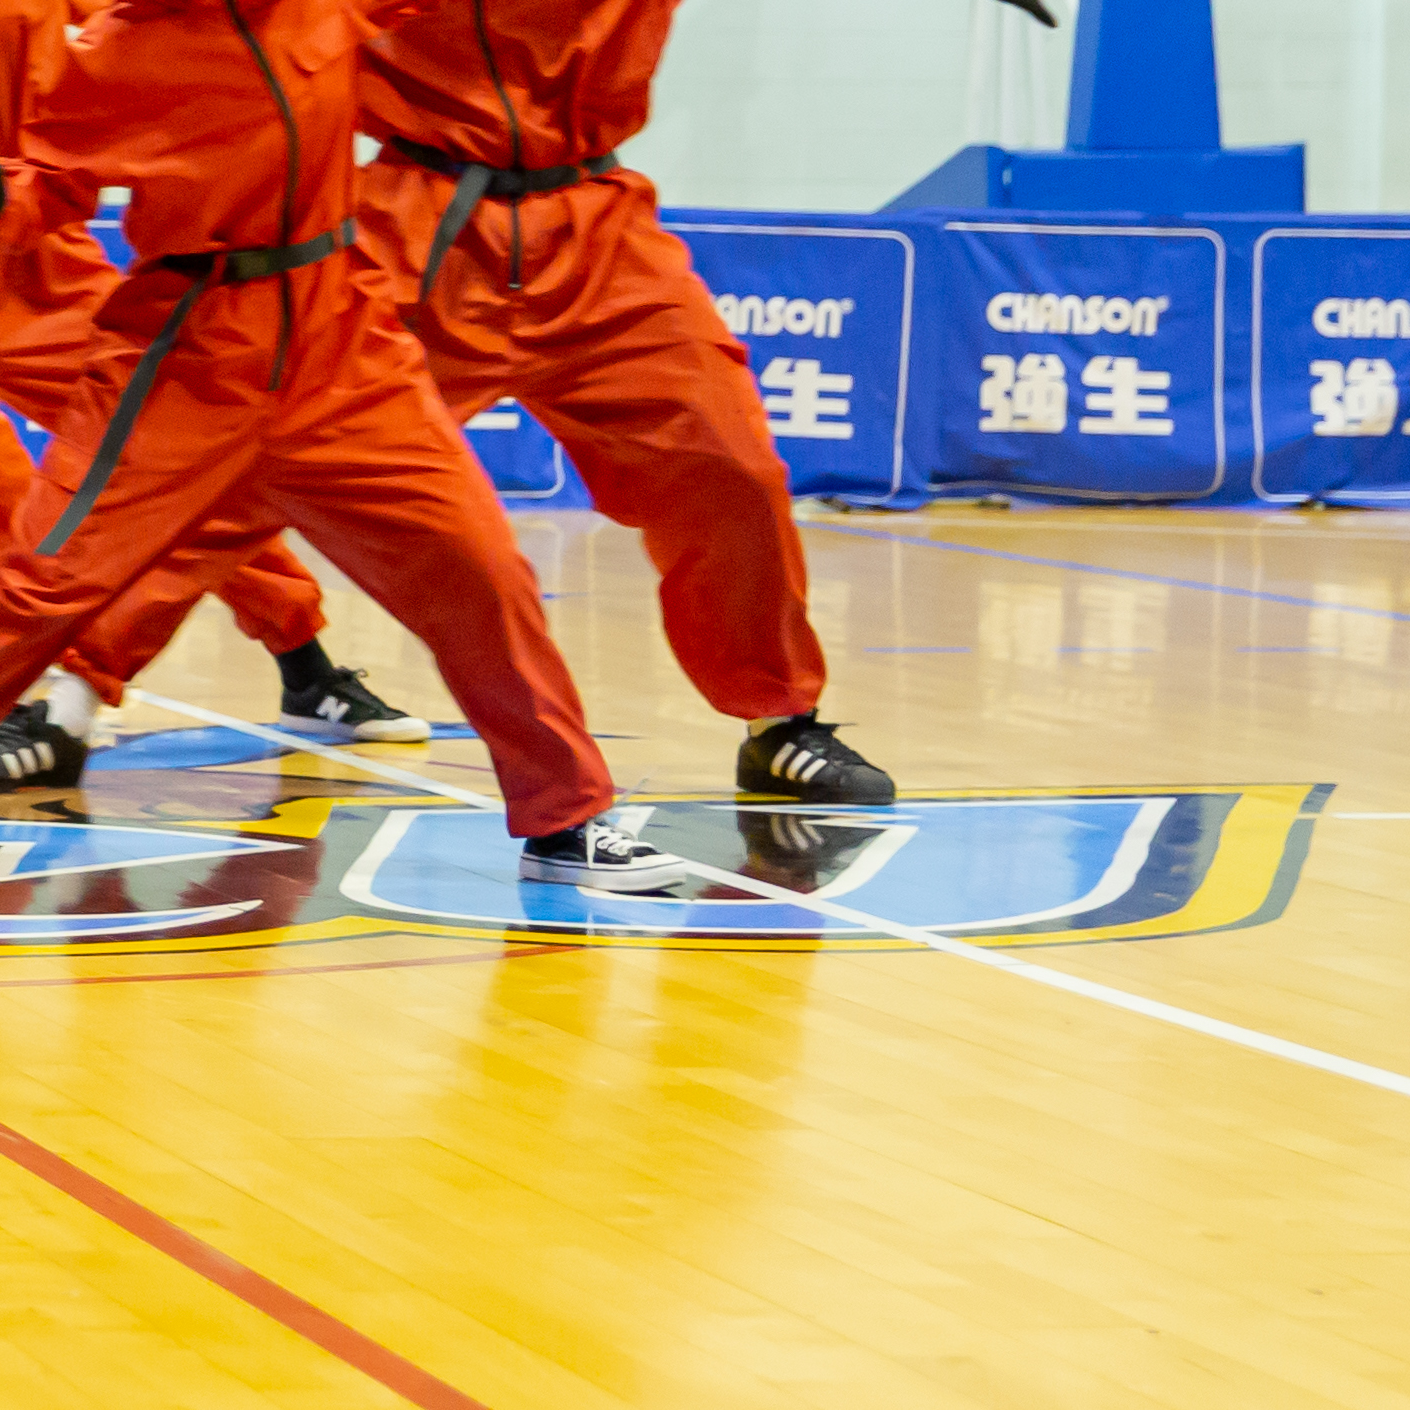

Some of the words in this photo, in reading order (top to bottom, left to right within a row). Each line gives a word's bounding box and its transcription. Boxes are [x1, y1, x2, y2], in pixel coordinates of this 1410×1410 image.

[986, 291, 1159, 337] CHANSON
[979, 352, 1175, 436] 強生
[1308, 356, 1410, 437] 強
